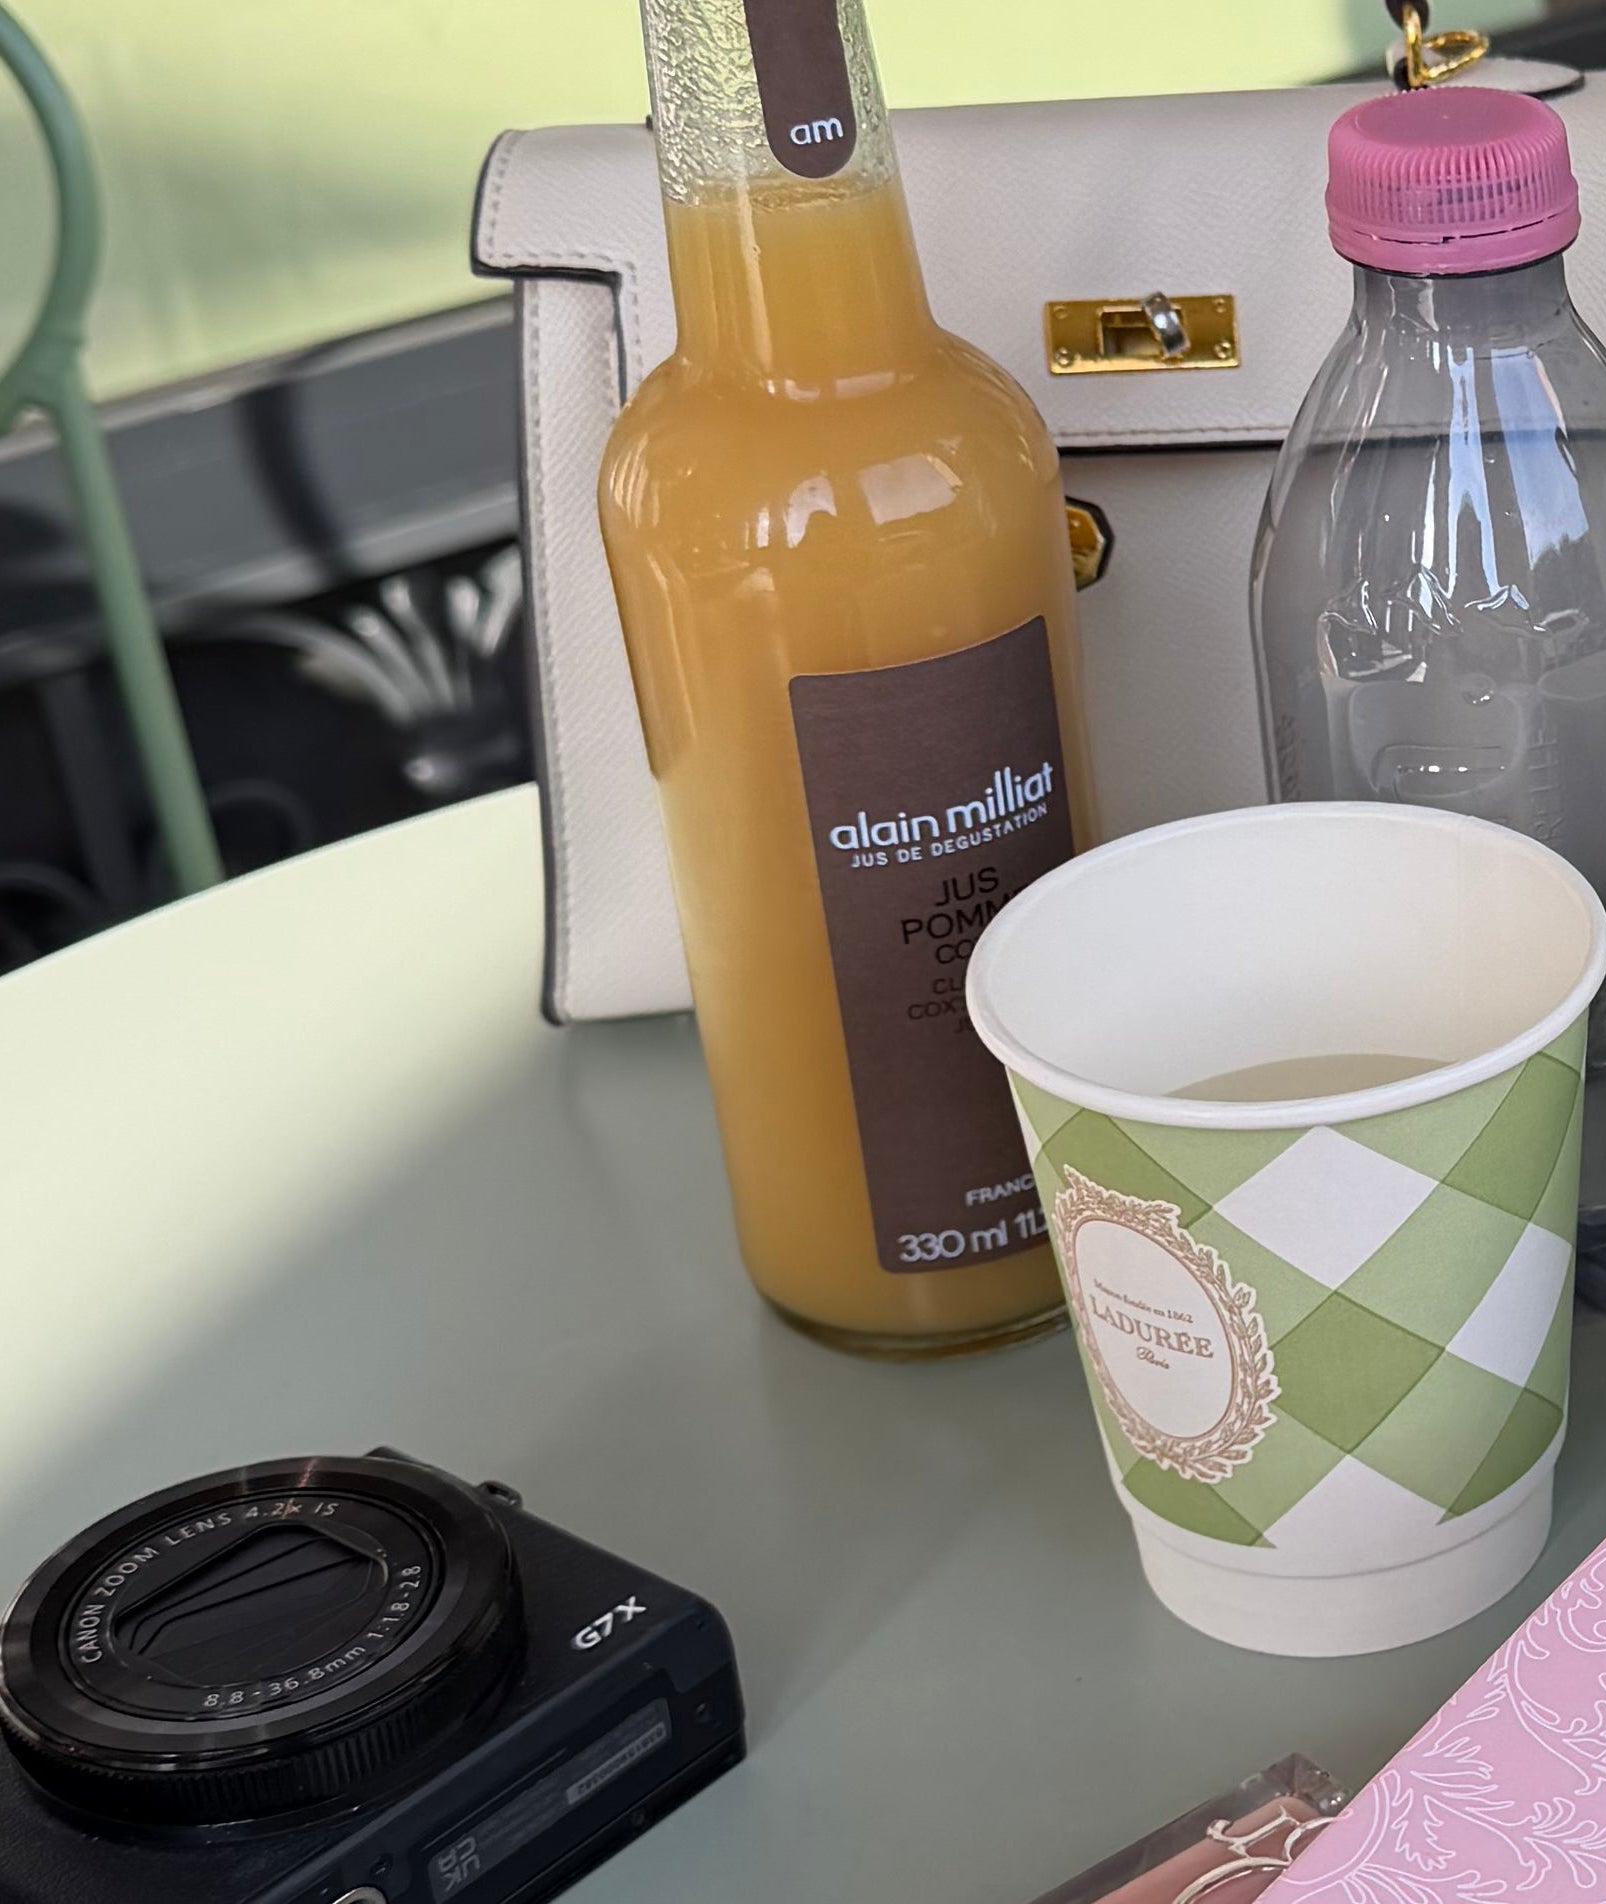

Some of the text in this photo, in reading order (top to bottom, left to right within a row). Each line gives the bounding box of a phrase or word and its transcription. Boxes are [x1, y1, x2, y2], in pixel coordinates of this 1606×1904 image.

[789, 117, 844, 145] am
[829, 761, 1054, 850] alain milliat
[850, 802, 1048, 868] JUS DE DEGUSTATION
[935, 866, 999, 907] JUS
[935, 939, 977, 964] CO
[964, 1173, 1035, 1207] FRANC
[897, 1229, 966, 1262] 330
[969, 1219, 1009, 1253] ml
[1089, 1294, 1215, 1358] LADURÉE
[77, 1603, 105, 1664] CANON
[94, 1546, 160, 1597] ZOOM
[164, 1511, 233, 1546] LENS
[314, 1501, 341, 1517] IS
